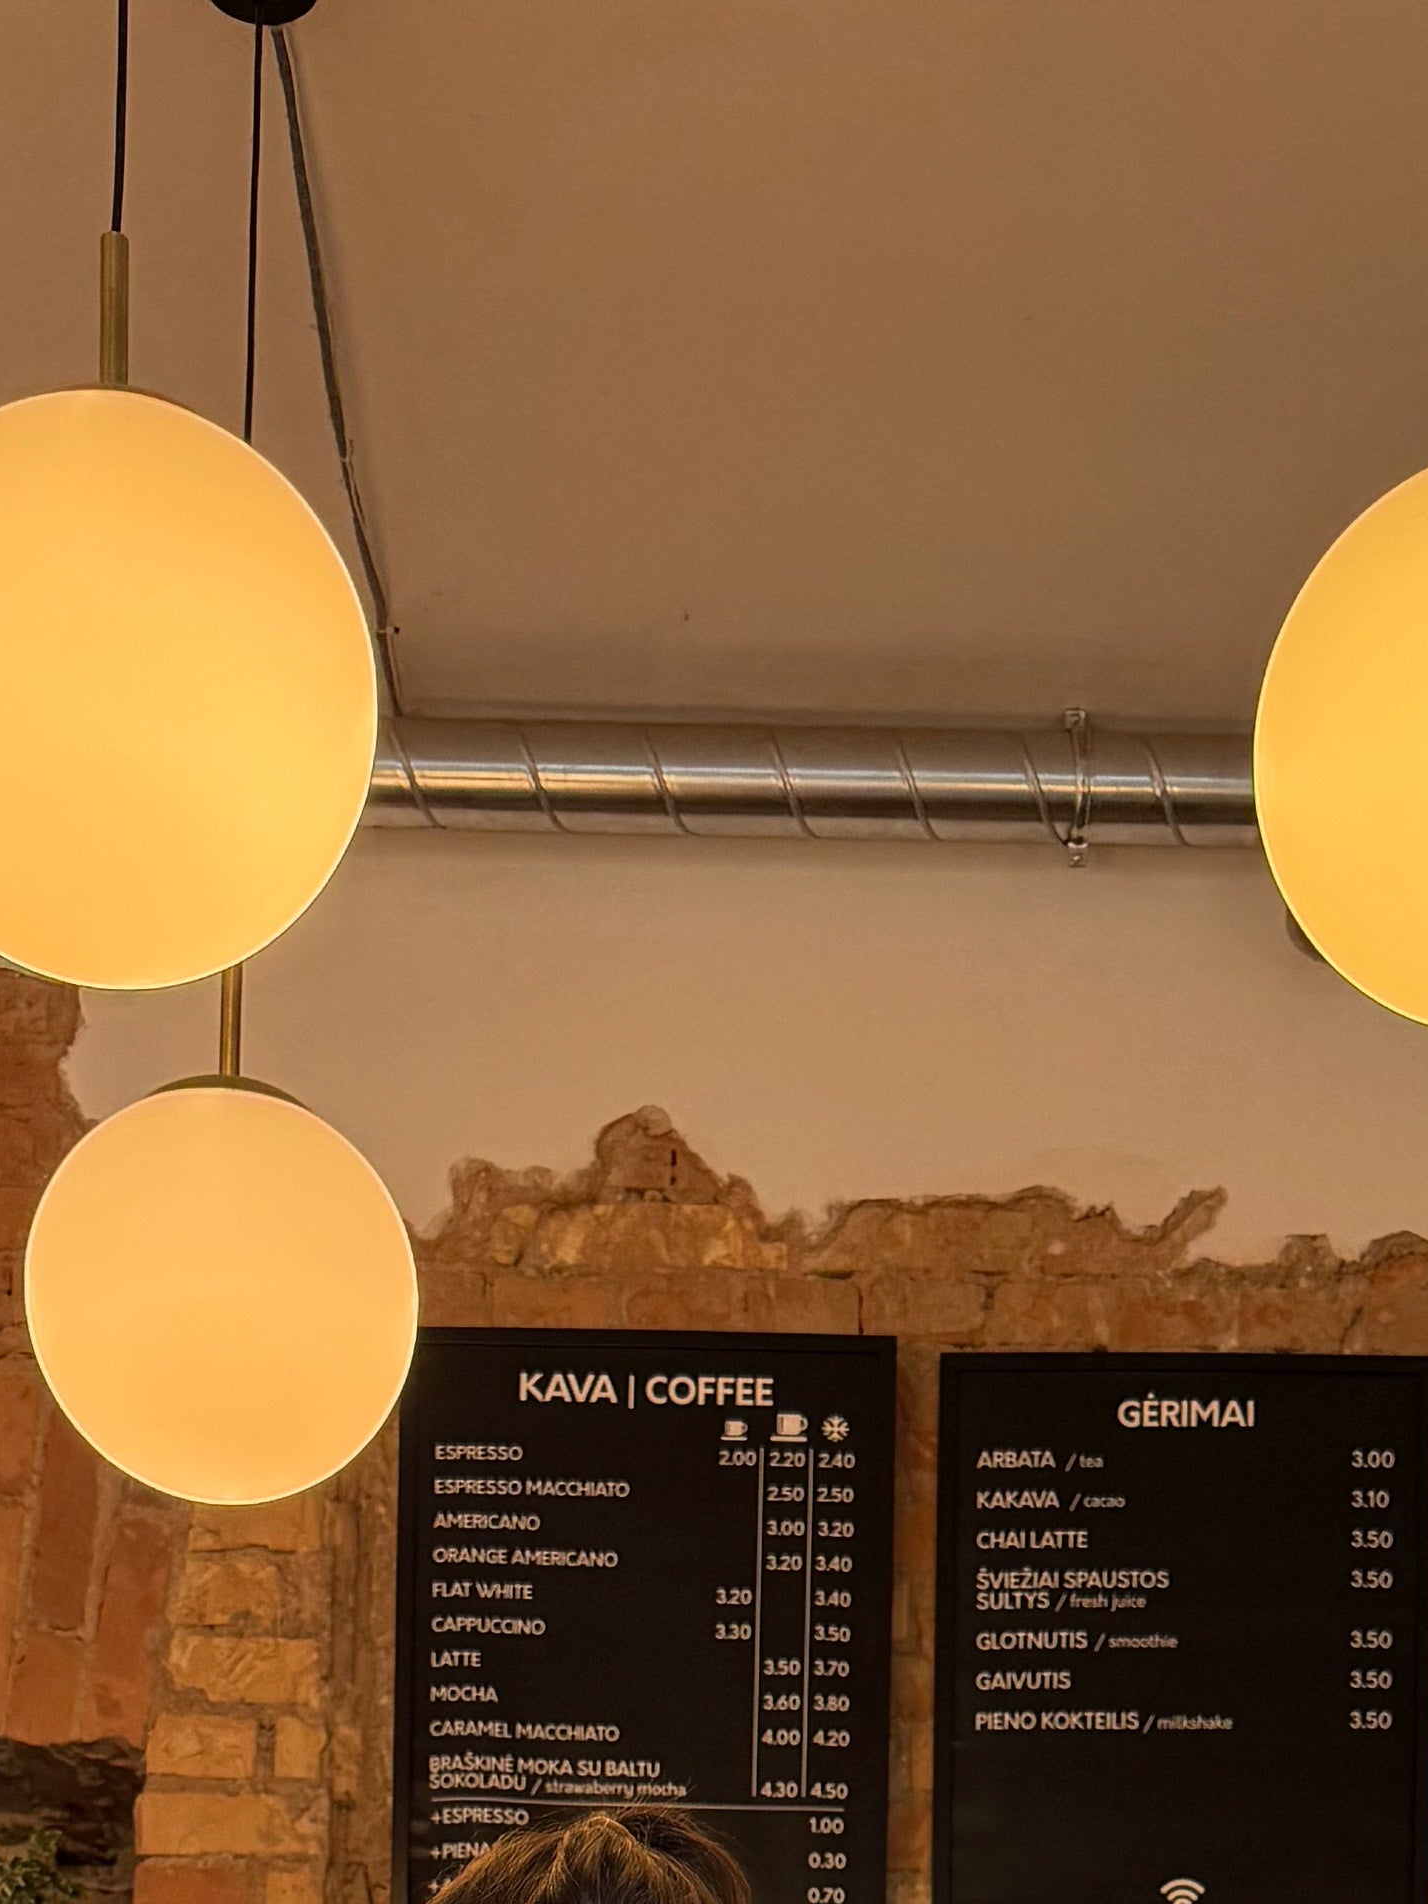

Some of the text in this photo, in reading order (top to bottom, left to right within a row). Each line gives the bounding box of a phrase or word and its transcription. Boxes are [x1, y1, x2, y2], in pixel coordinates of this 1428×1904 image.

[520, 1373, 773, 1406] KAVA COFFEE
[1118, 1393, 1254, 1427] GĖRIMAI
[435, 1445, 855, 1468] ESPRESSO 2.00 2.20 2.40
[977, 1450, 1395, 1469] ARBATA tea 3.00
[435, 1479, 854, 1502] ESPRESSO MACCHIATO 2.50 2.50
[977, 1490, 1389, 1508] KAKAVA cacao 3.10
[434, 1513, 854, 1537] AMERICANO 3.00 3.20
[977, 1530, 1393, 1549] CHAI LATTE 3.50
[433, 1548, 852, 1572] ORANGE AMERICANO 3.20 3.40
[976, 1567, 1393, 1590] ŠVIEŽIAI SPAUSTOS 3.50
[432, 1582, 851, 1607] FLAT WHITE 3.20 3.40
[977, 1591, 1050, 1610] SULTYS
[432, 1616, 851, 1642] CAPPUCCINO 3.30 3.50
[976, 1632, 1087, 1650] GLOTNUTIS
[1351, 1631, 1392, 1649] 3.50
[431, 1651, 849, 1677] LATTE 3.50 3.70
[976, 1671, 1392, 1690] GAIVUTIS 3.50
[430, 1686, 498, 1702] MOCHA
[764, 1695, 800, 1710] 3.60
[976, 1712, 1036, 1730] PIENO
[1041, 1712, 1139, 1730] KOKTEILIS
[1350, 1711, 1392, 1729] 3.50
[430, 1720, 850, 1746] CARAMEL MACCHIATO 4.00 4.20
[518, 1758, 573, 1775] MOKA
[577, 1760, 601, 1776] SU
[605, 1760, 660, 1778] BALTU
[761, 1782, 798, 1798] 4.30
[811, 1783, 848, 1799] 4.50
[431, 1807, 844, 1834] +ESPRESSO 1.00
[809, 1852, 846, 1869] 0.30
[808, 1888, 845, 1904] 0.70
